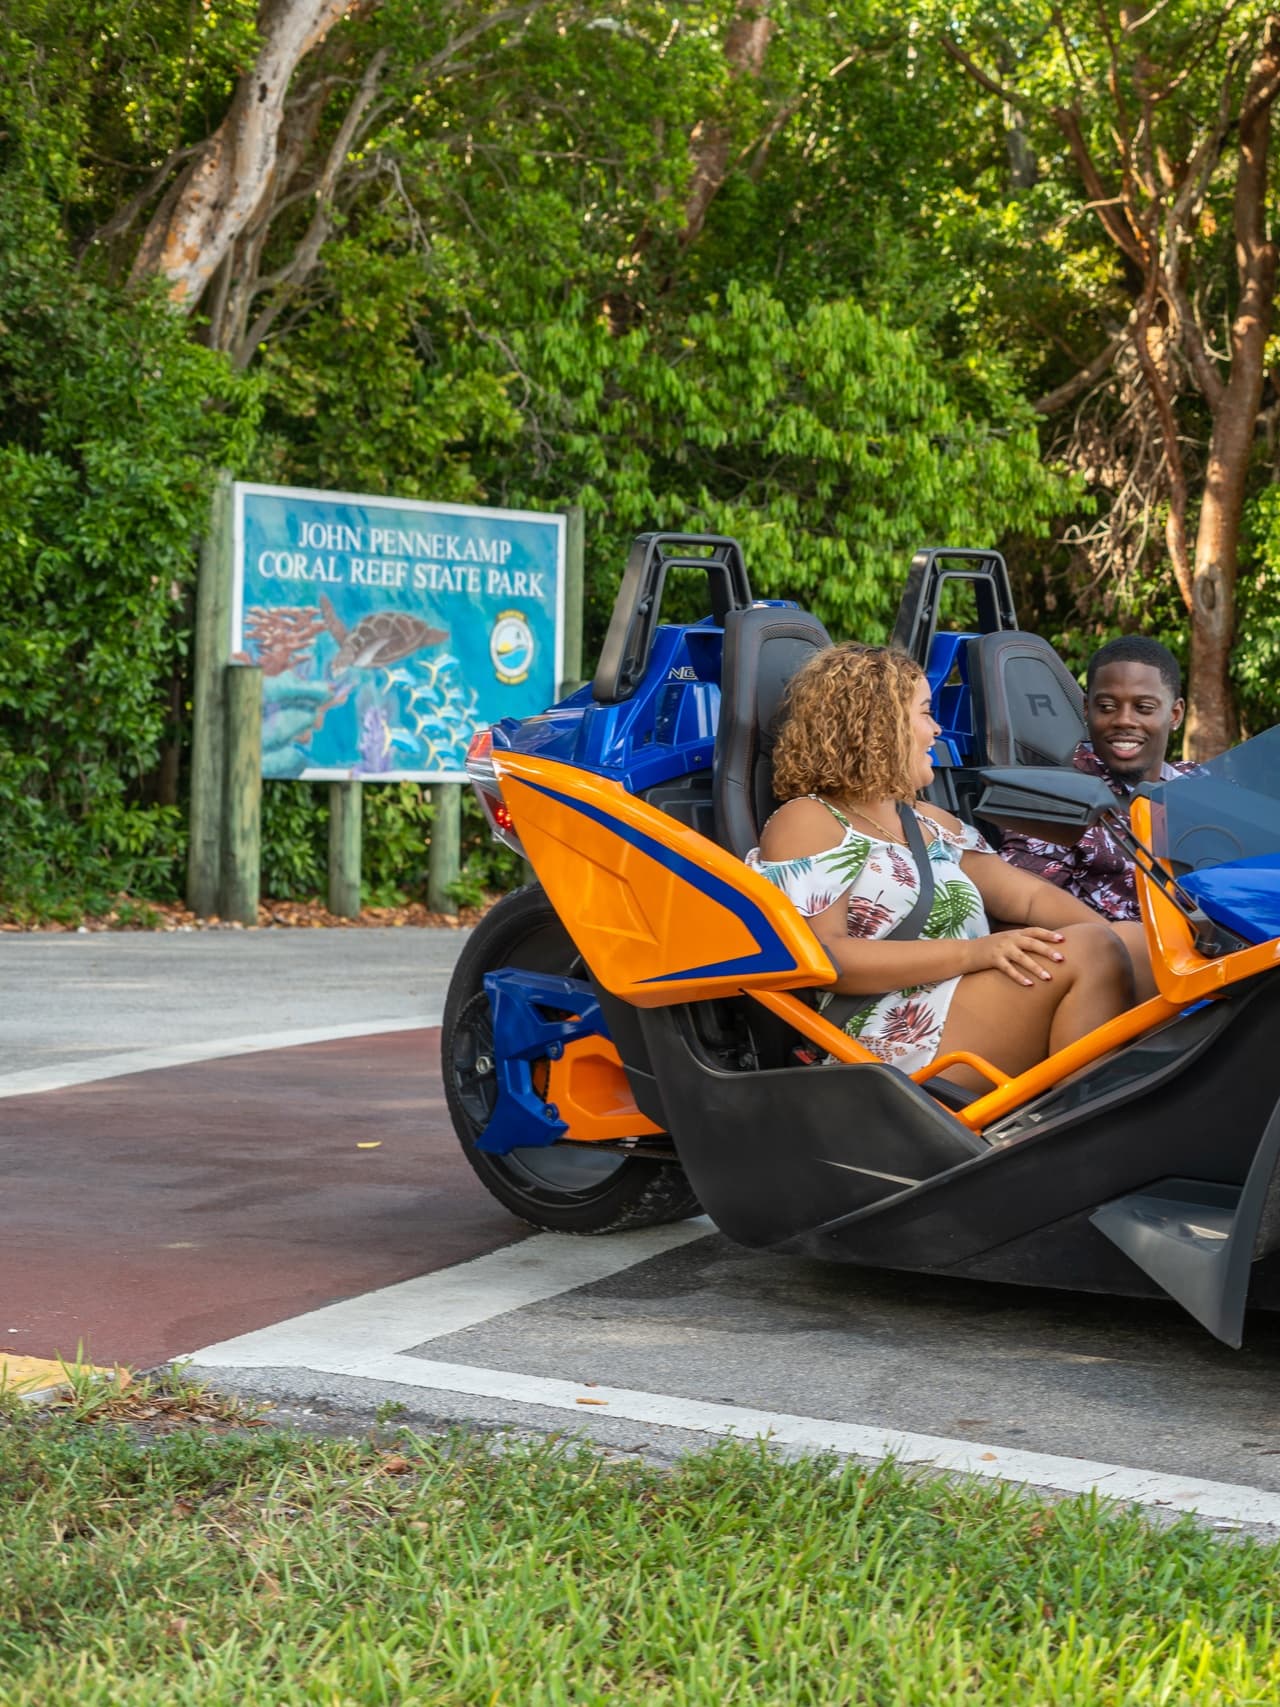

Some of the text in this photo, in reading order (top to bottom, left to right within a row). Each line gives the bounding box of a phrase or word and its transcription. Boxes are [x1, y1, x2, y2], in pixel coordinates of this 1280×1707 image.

[298, 522, 512, 564] JOHN PENNEKAMP
[258, 550, 544, 597] CORAL REEF STATE PARK
[1024, 694, 1058, 717] R
